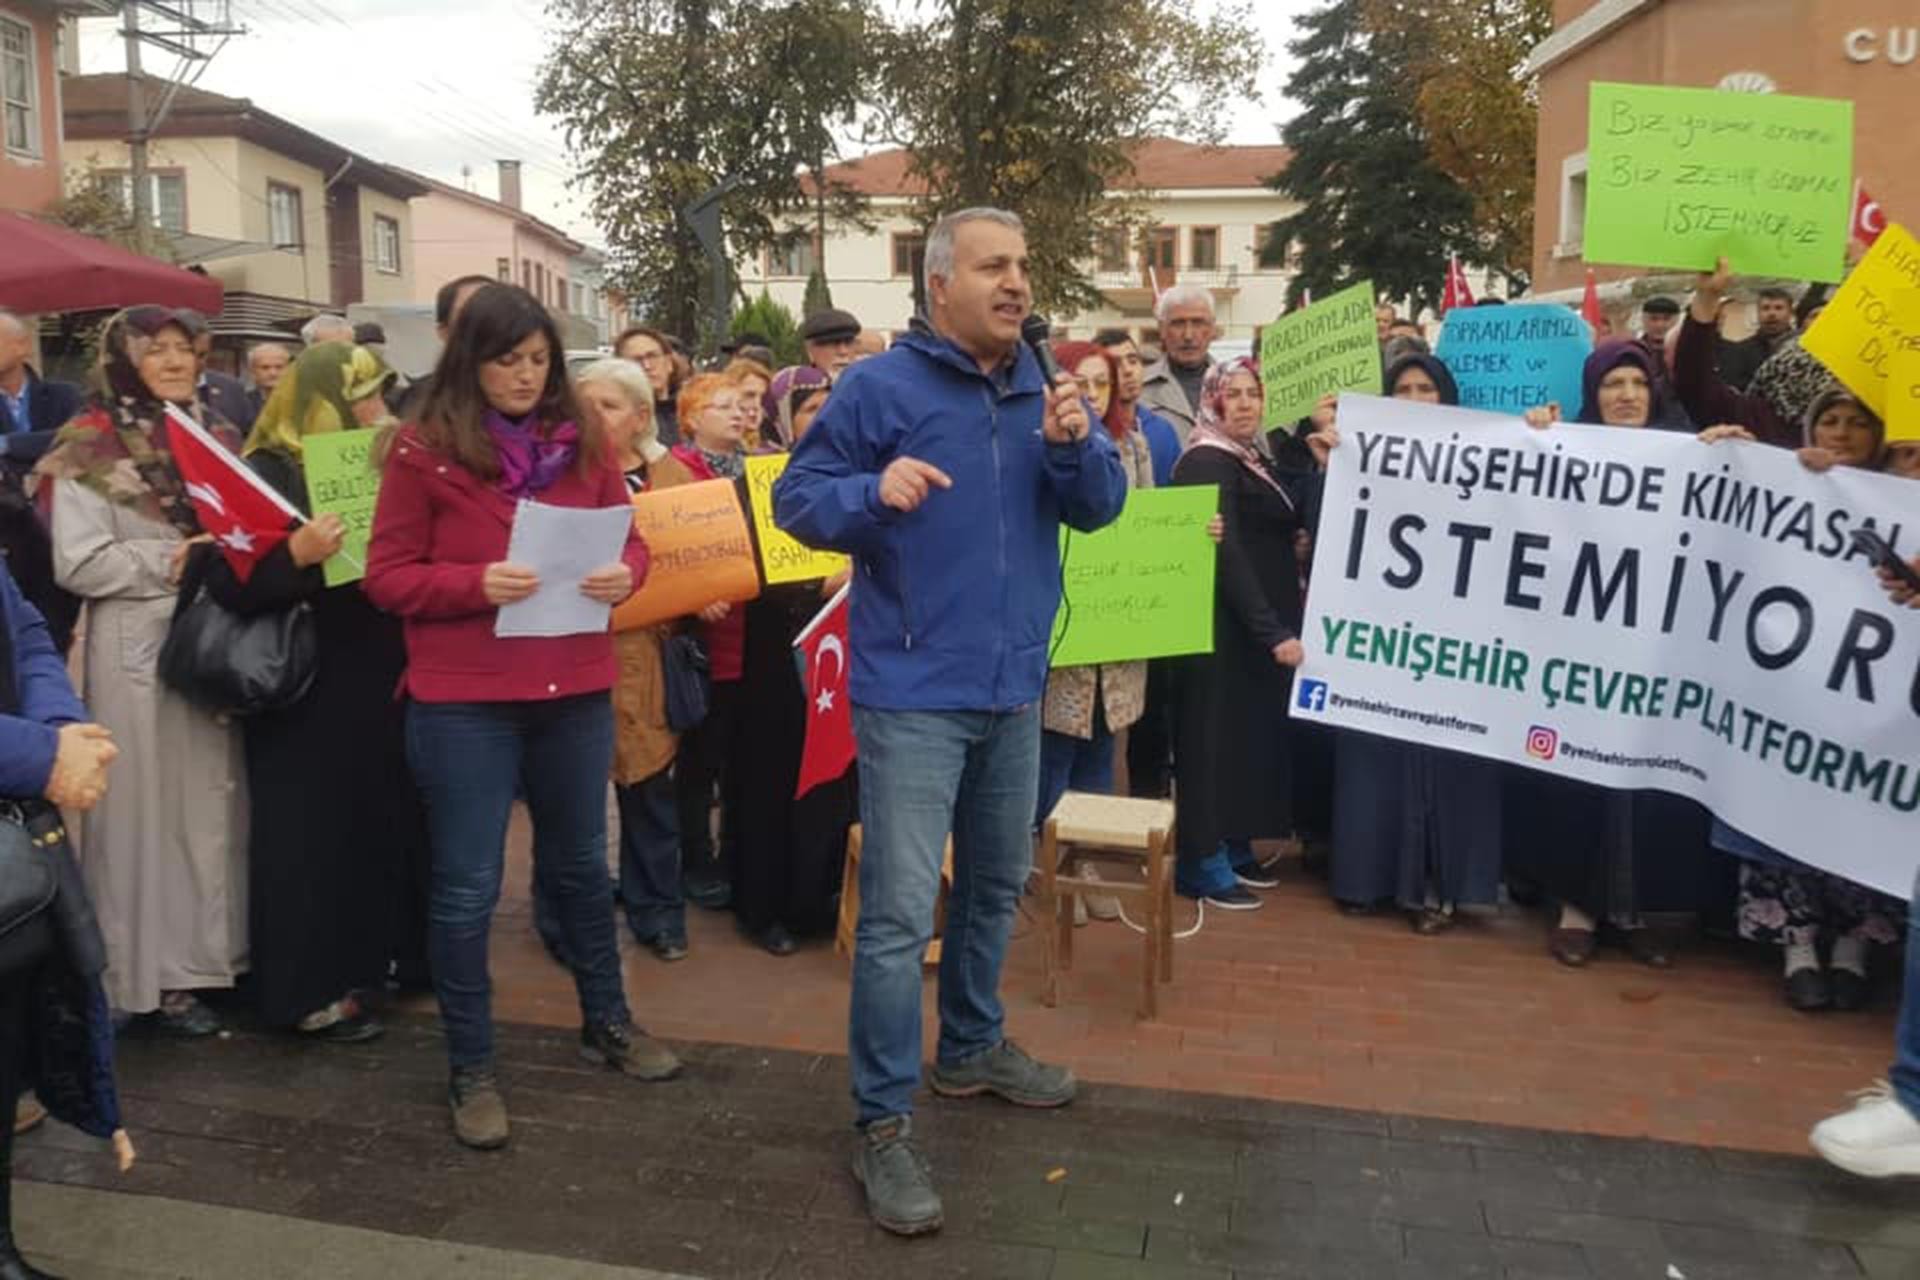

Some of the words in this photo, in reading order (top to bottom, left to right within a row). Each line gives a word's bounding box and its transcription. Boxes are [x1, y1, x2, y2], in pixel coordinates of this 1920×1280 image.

[1355, 431, 1665, 514] YENİŞEHİR'DE
[1345, 486, 1920, 718] İSTEMİYOR
[1321, 616, 1529, 691] YENİŞEHİR
[1541, 657, 1669, 718] ÇEVRE
[1672, 678, 1920, 812] PLATFORMU
